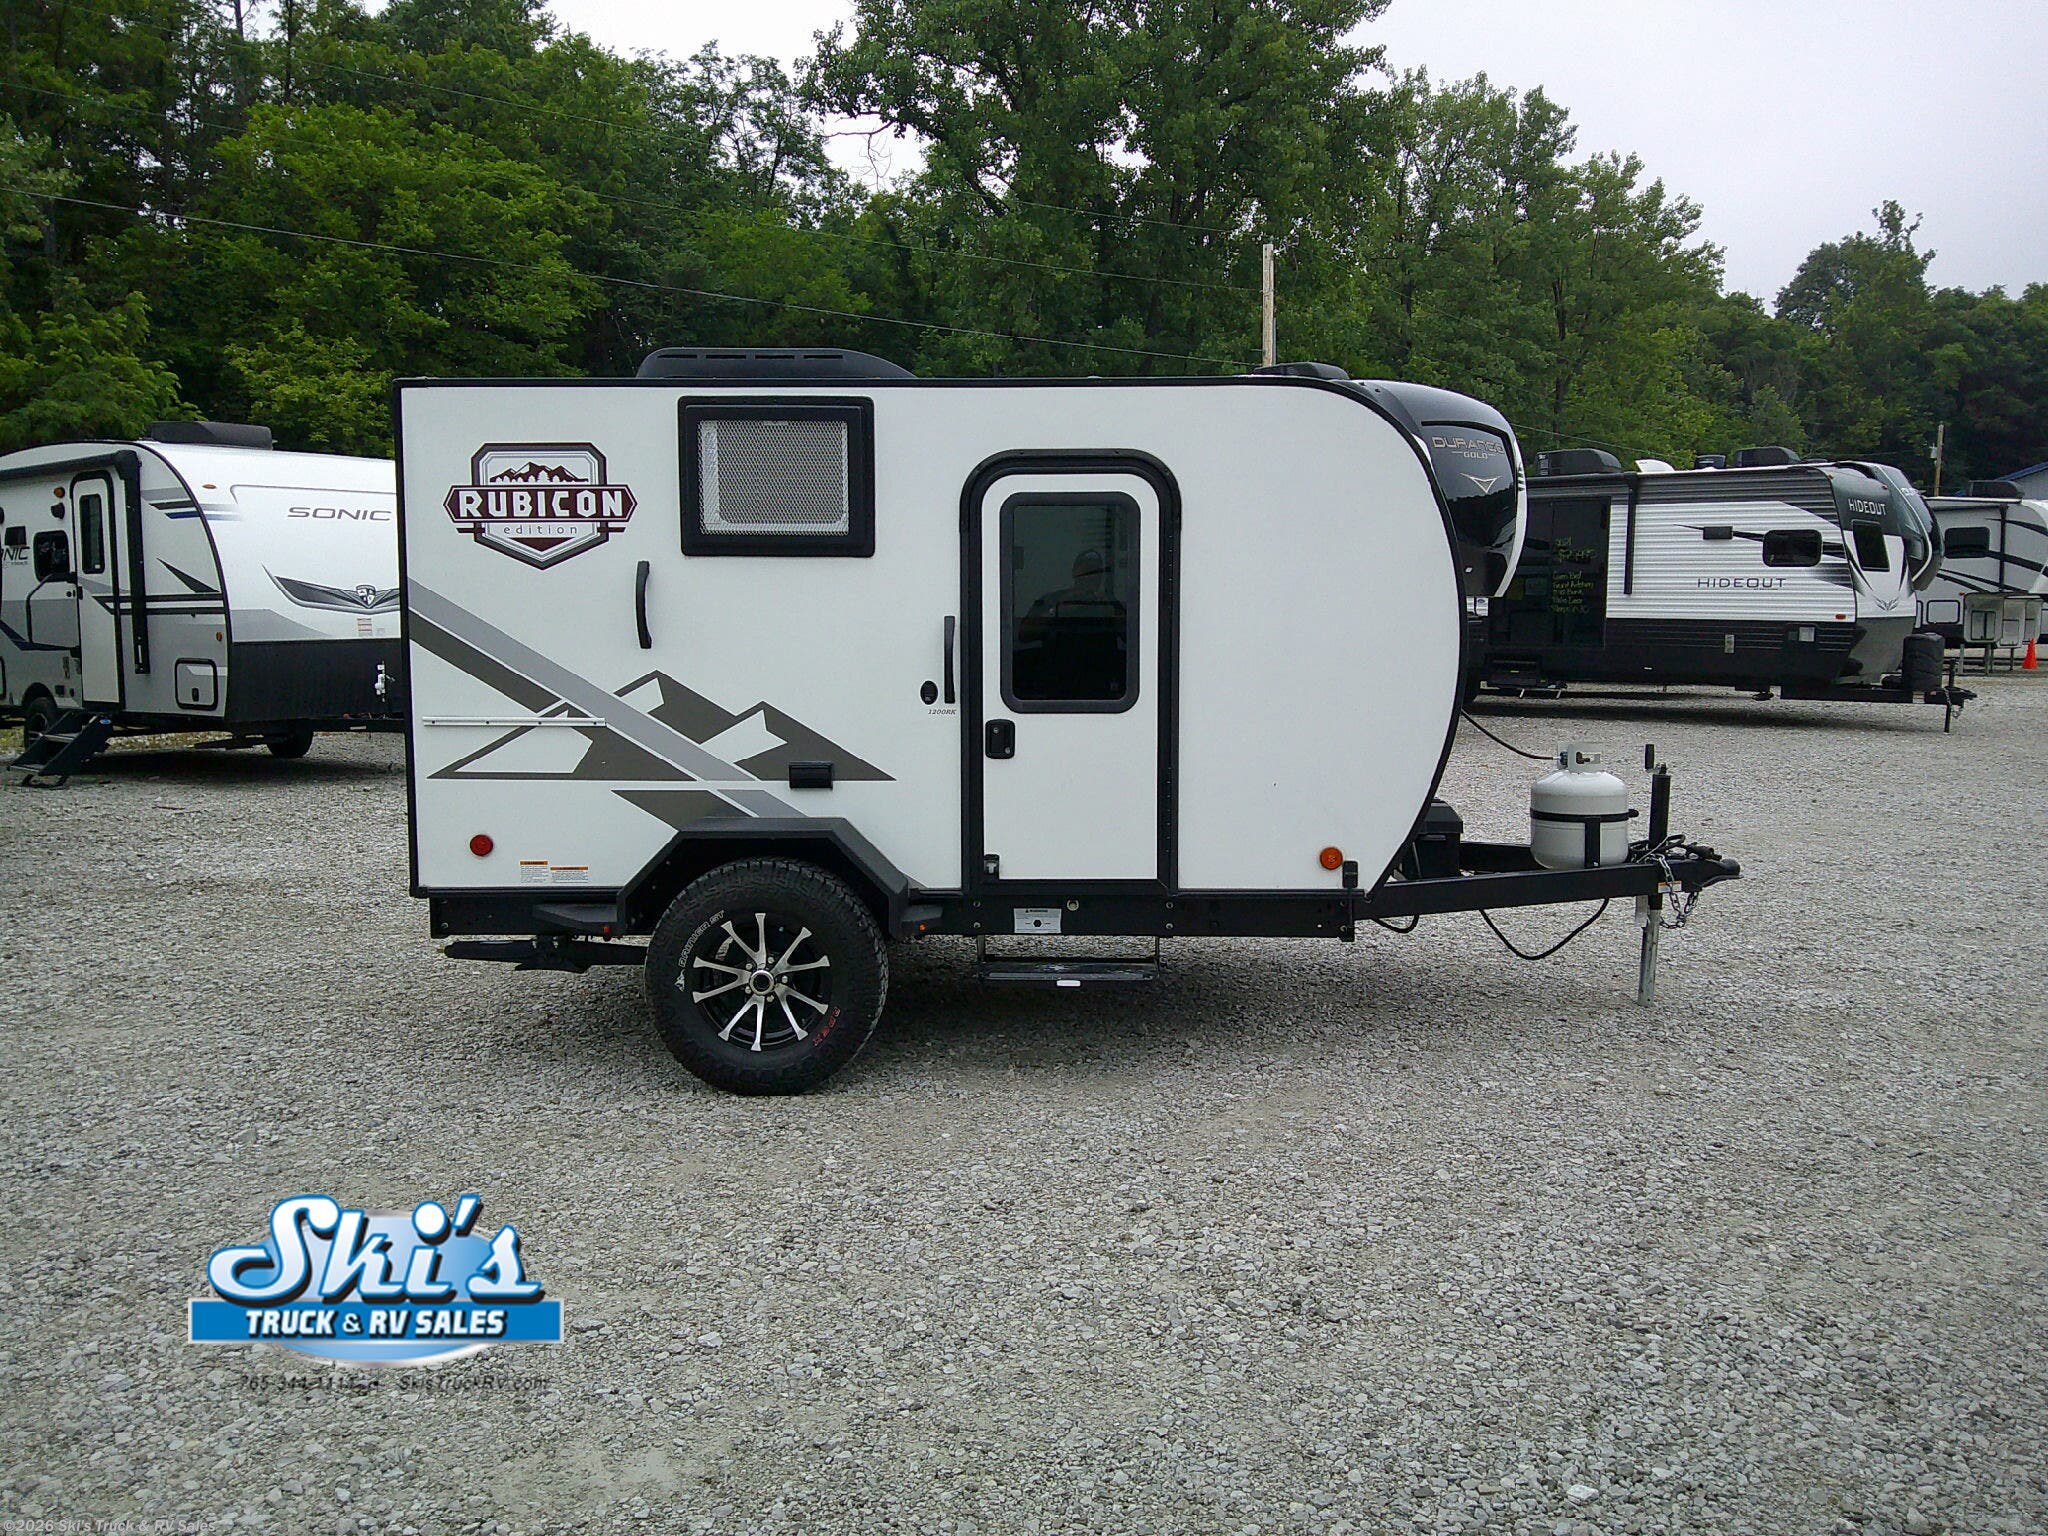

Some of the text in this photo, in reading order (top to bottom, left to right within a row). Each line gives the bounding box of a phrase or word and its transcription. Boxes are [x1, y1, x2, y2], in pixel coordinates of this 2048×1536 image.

[1463, 451, 1488, 460] GOLD
[458, 489, 623, 518] RUBICON
[1847, 498, 1887, 516] HIDEOUT
[287, 506, 392, 522] SONIC
[503, 523, 579, 535] edition
[1, 546, 30, 561] NIC
[1697, 577, 1787, 588] HIDEOUT
